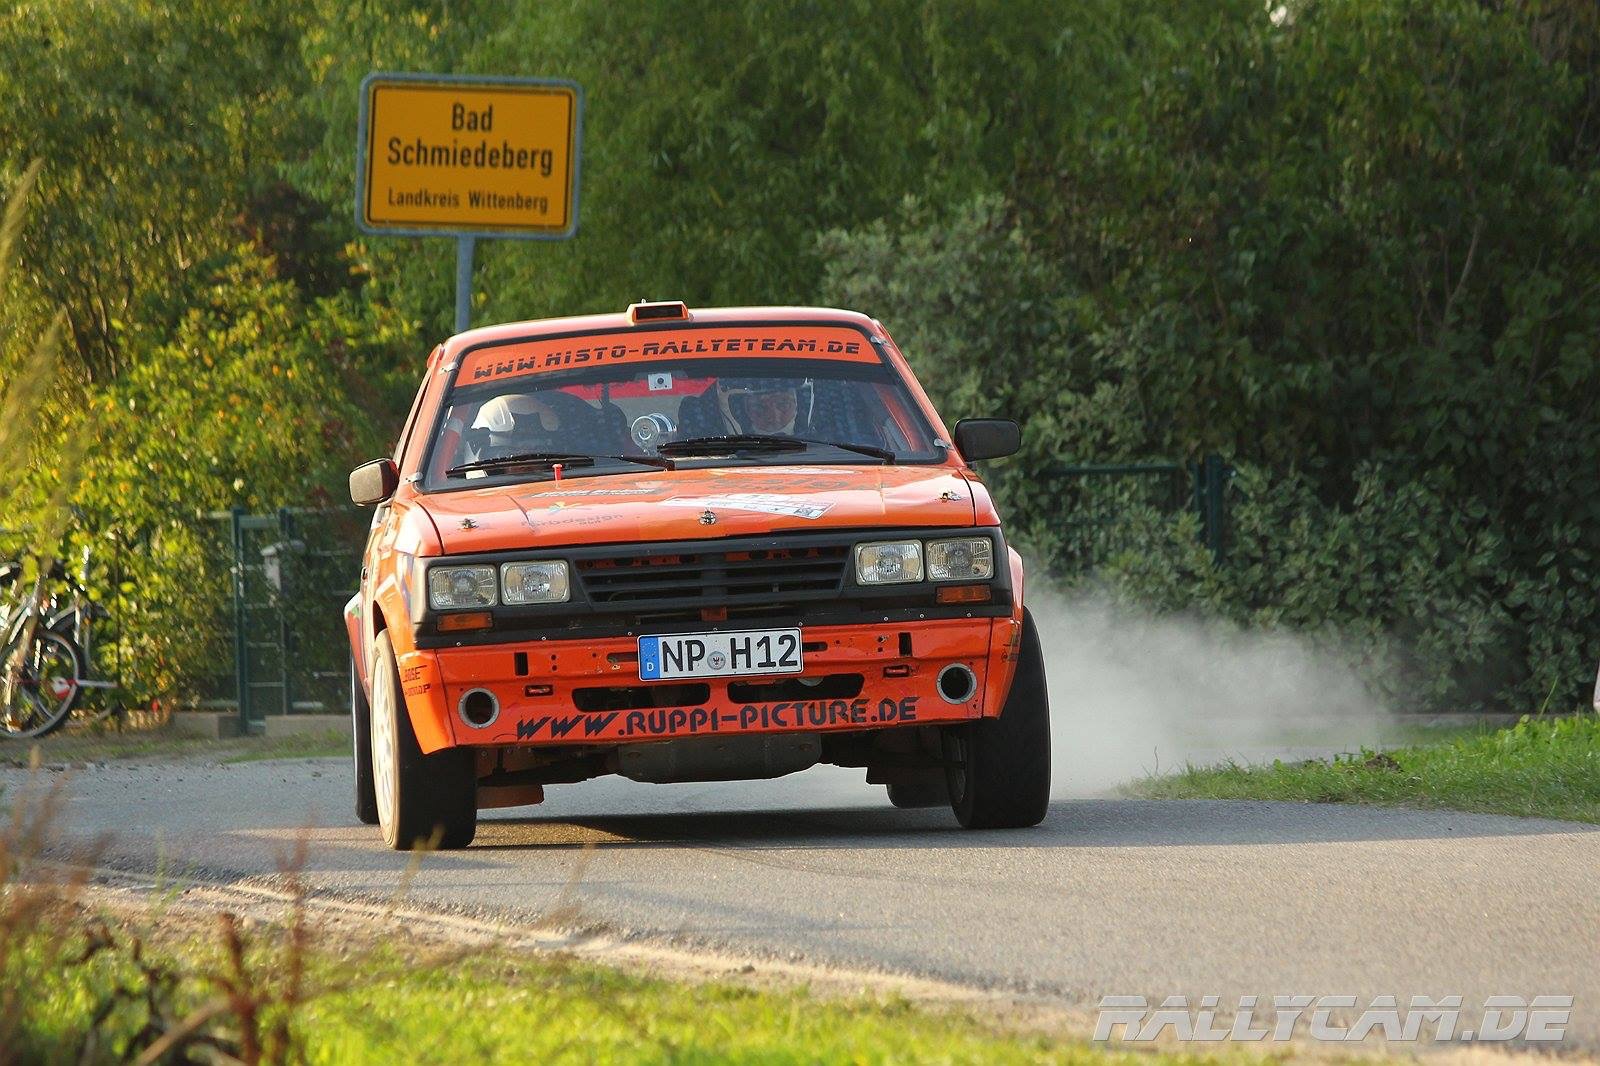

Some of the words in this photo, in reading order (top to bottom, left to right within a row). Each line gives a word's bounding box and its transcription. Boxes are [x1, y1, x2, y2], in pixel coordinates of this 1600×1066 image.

[451, 102, 494, 132] Bad
[387, 136, 553, 178] Schmiedeberg
[388, 187, 460, 208] Landkreis
[467, 190, 549, 215] Wittenberg
[646, 661, 654, 672] D
[661, 639, 706, 673] NP
[729, 634, 798, 669] H12
